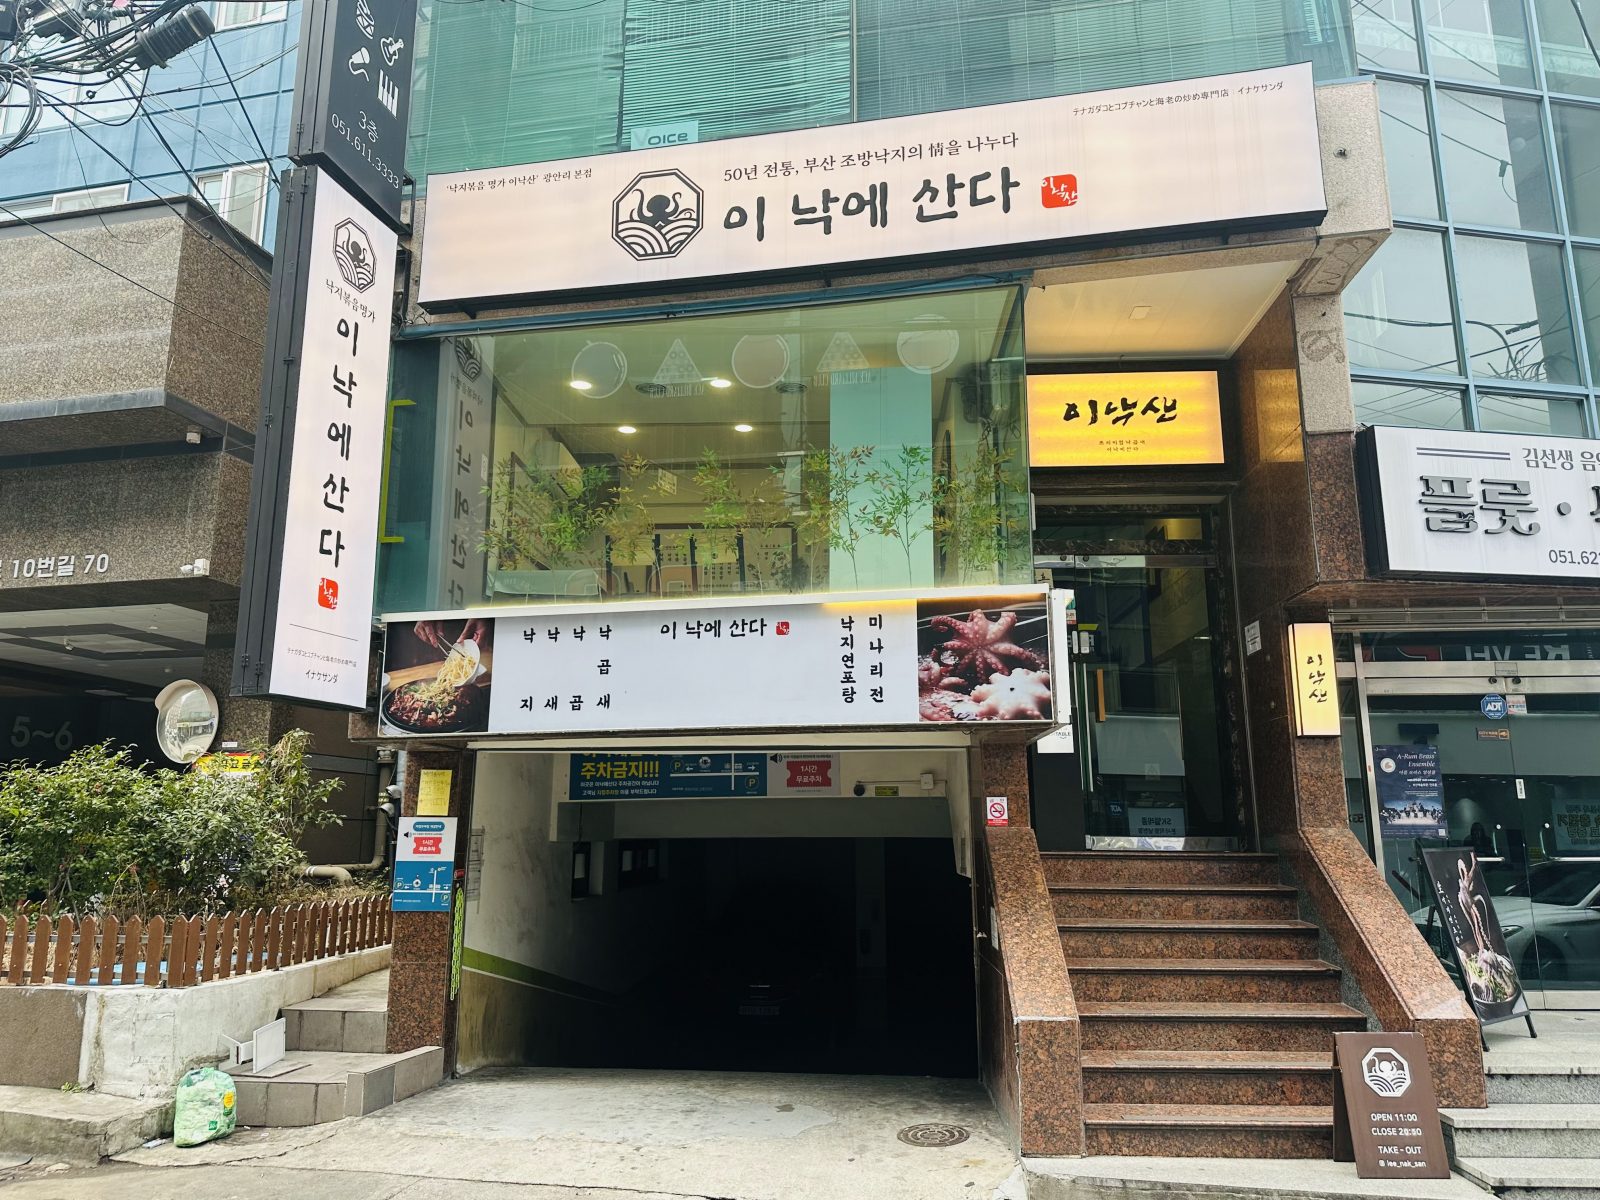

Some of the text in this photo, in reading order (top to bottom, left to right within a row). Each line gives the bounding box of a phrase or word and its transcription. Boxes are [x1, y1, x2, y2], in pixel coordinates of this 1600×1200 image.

[358, 110, 379, 143] 3층
[331, 113, 399, 189] 051.611.3333
[724, 132, 1019, 182] 50년 전통, 부산 조방낙지의 情을 나누다
[488, 178, 506, 190] 명가
[543, 170, 571, 184] 광안리
[574, 167, 593, 181] 본점
[723, 166, 1021, 242] 이 낙에 산다
[325, 277, 376, 323] 낙지볶음명가
[1063, 396, 1178, 426] 이낙산
[318, 317, 360, 569] 이낙에산다
[1522, 447, 1574, 471] 김선생
[1418, 475, 1541, 537] 플룻
[12, 554, 76, 579] 10번길
[84, 553, 110, 574] 70
[660, 617, 768, 640] 이 낙에 산다
[839, 614, 857, 704] 낙지연포탕
[868, 613, 885, 704] 미나리전
[1306, 653, 1328, 704] 이낙산
[1485, 702, 1503, 711] ADT
[10, 715, 73, 751] 5~6
[580, 760, 660, 780] 주차금지!!!
[795, 774, 822, 784] 무료주차
[800, 764, 818, 773] 1시간
[1370, 1112, 1418, 1122] OPEN 11:00
[1371, 1127, 1397, 1136] CLOSE
[1377, 1145, 1422, 1155] TAKE OUT
